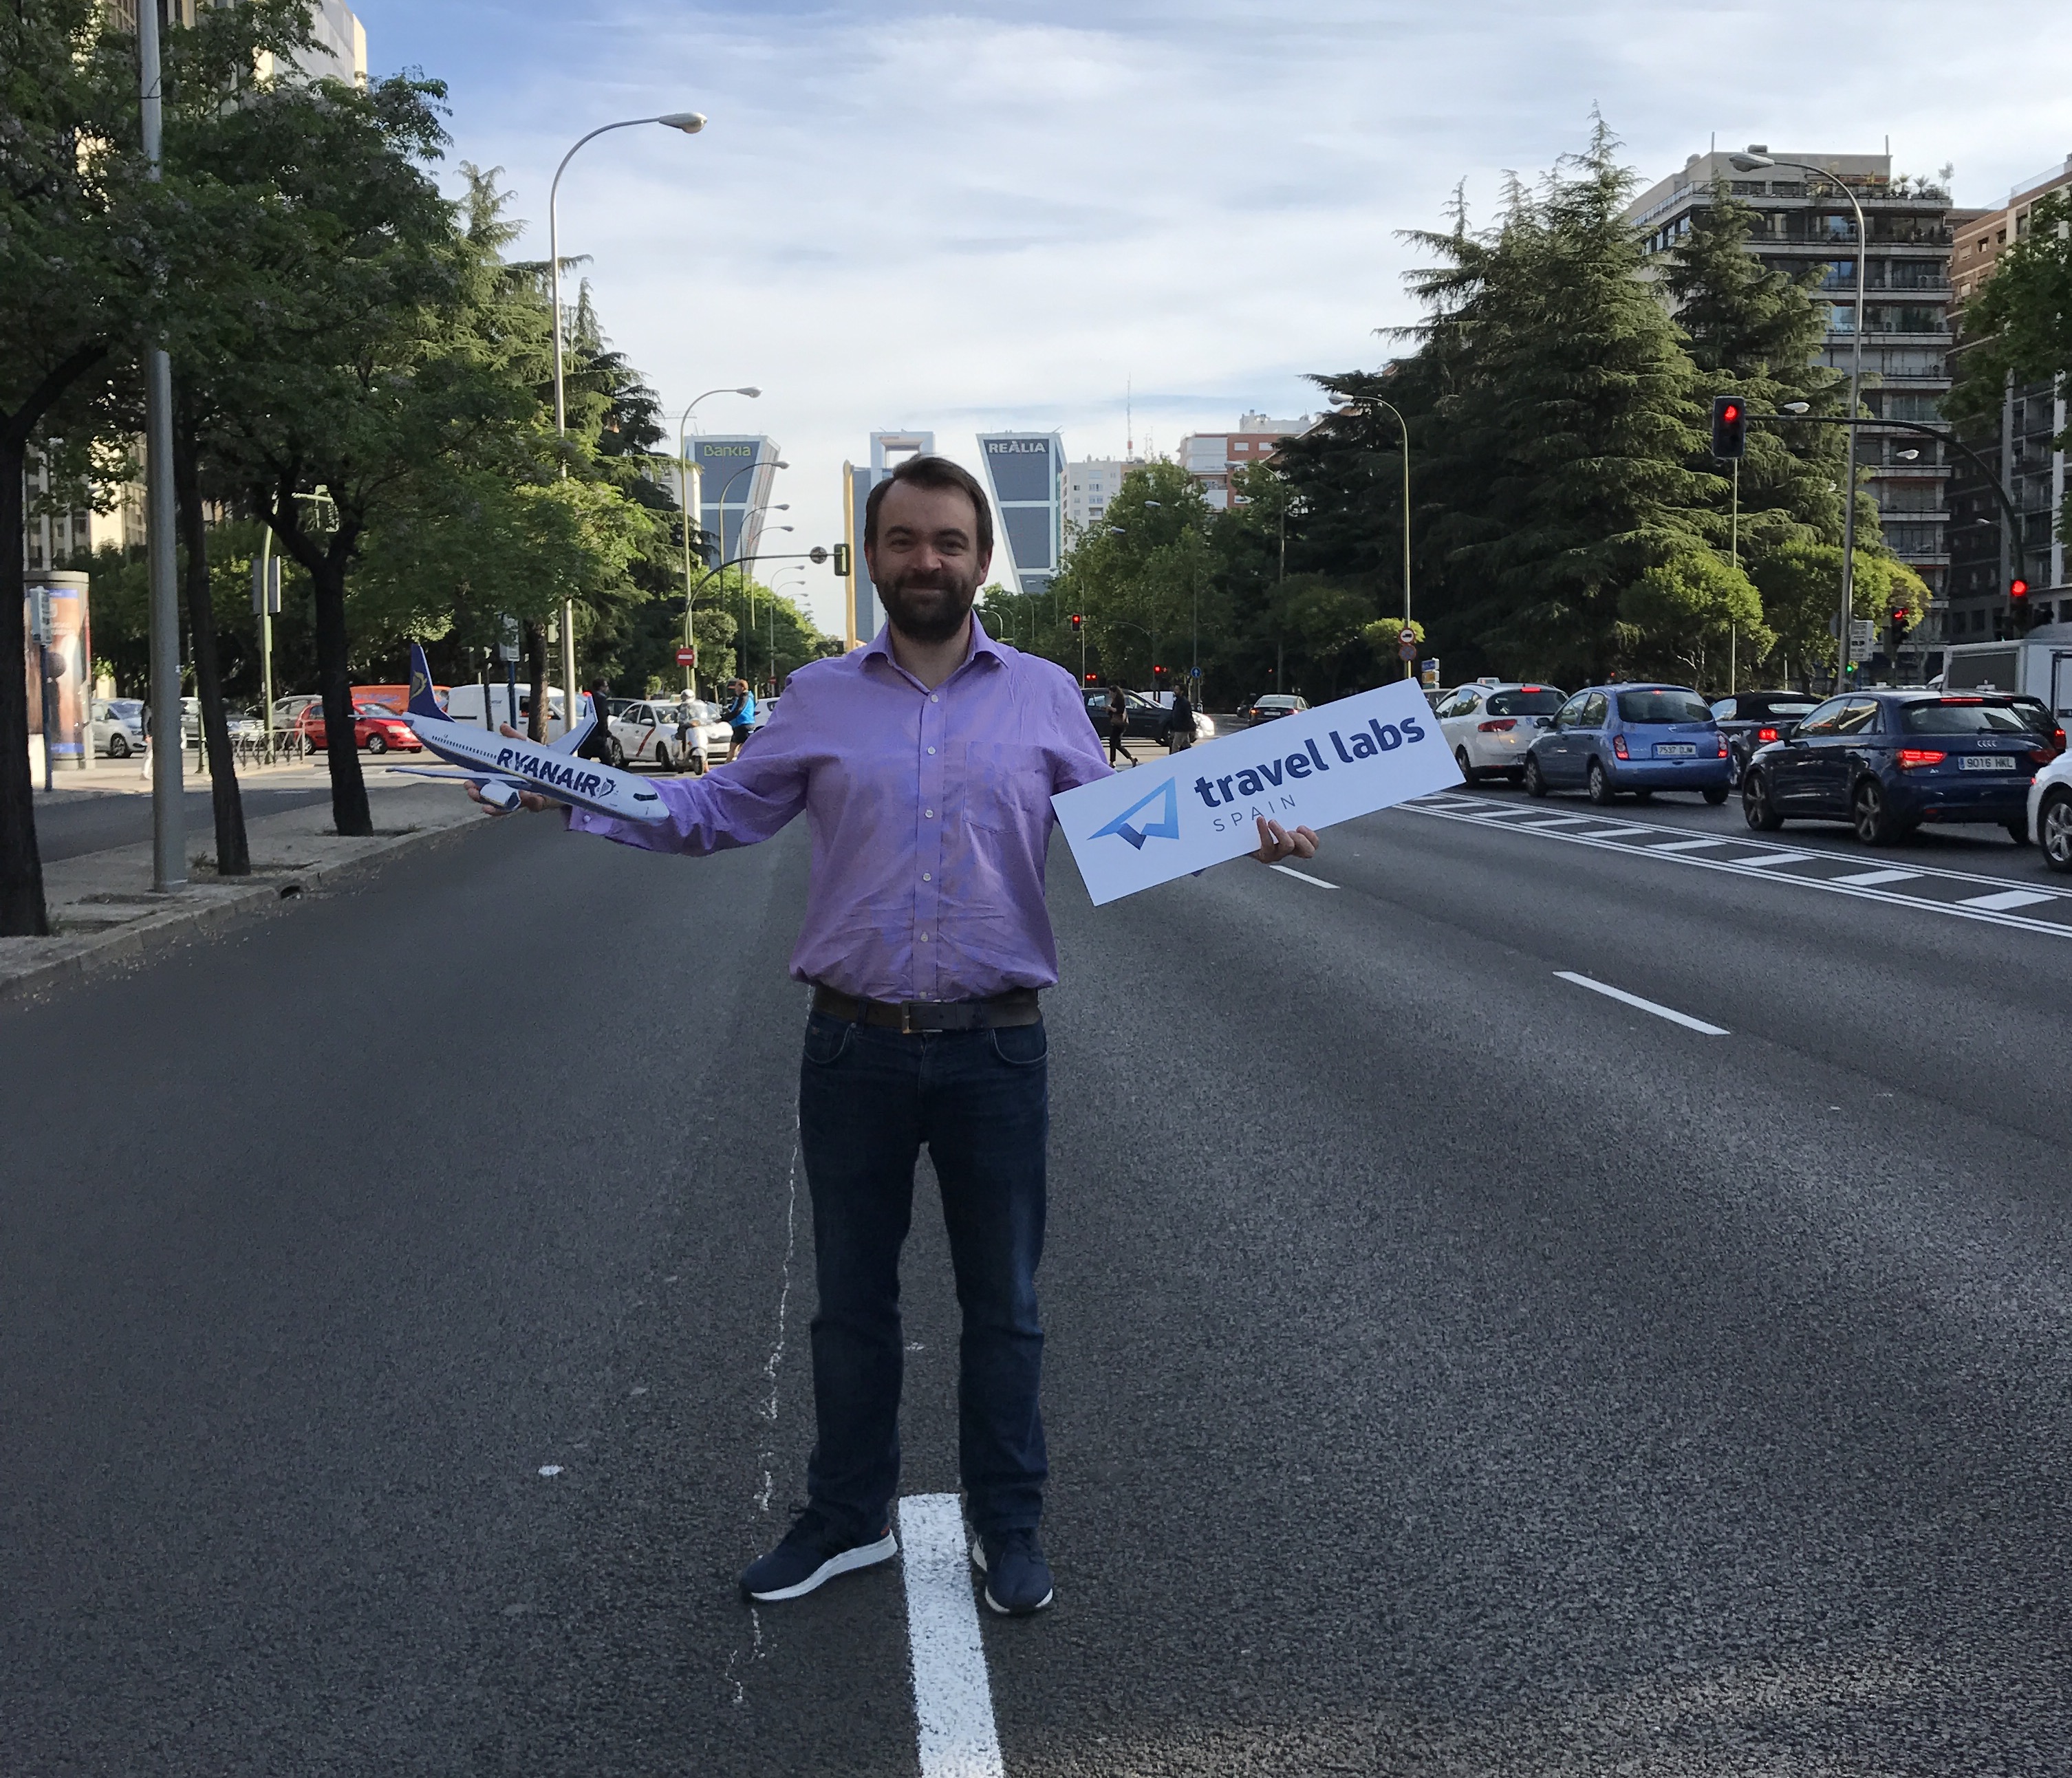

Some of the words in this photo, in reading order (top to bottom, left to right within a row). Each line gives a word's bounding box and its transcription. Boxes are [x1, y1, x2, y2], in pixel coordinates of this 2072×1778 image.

[704, 444, 751, 457] Bankia
[497, 748, 601, 798] RYANAIR
[1194, 738, 1330, 808] travel
[1328, 717, 1425, 763] labs
[1967, 758, 1992, 768] 9016
[1213, 794, 1296, 832] SPAIN
